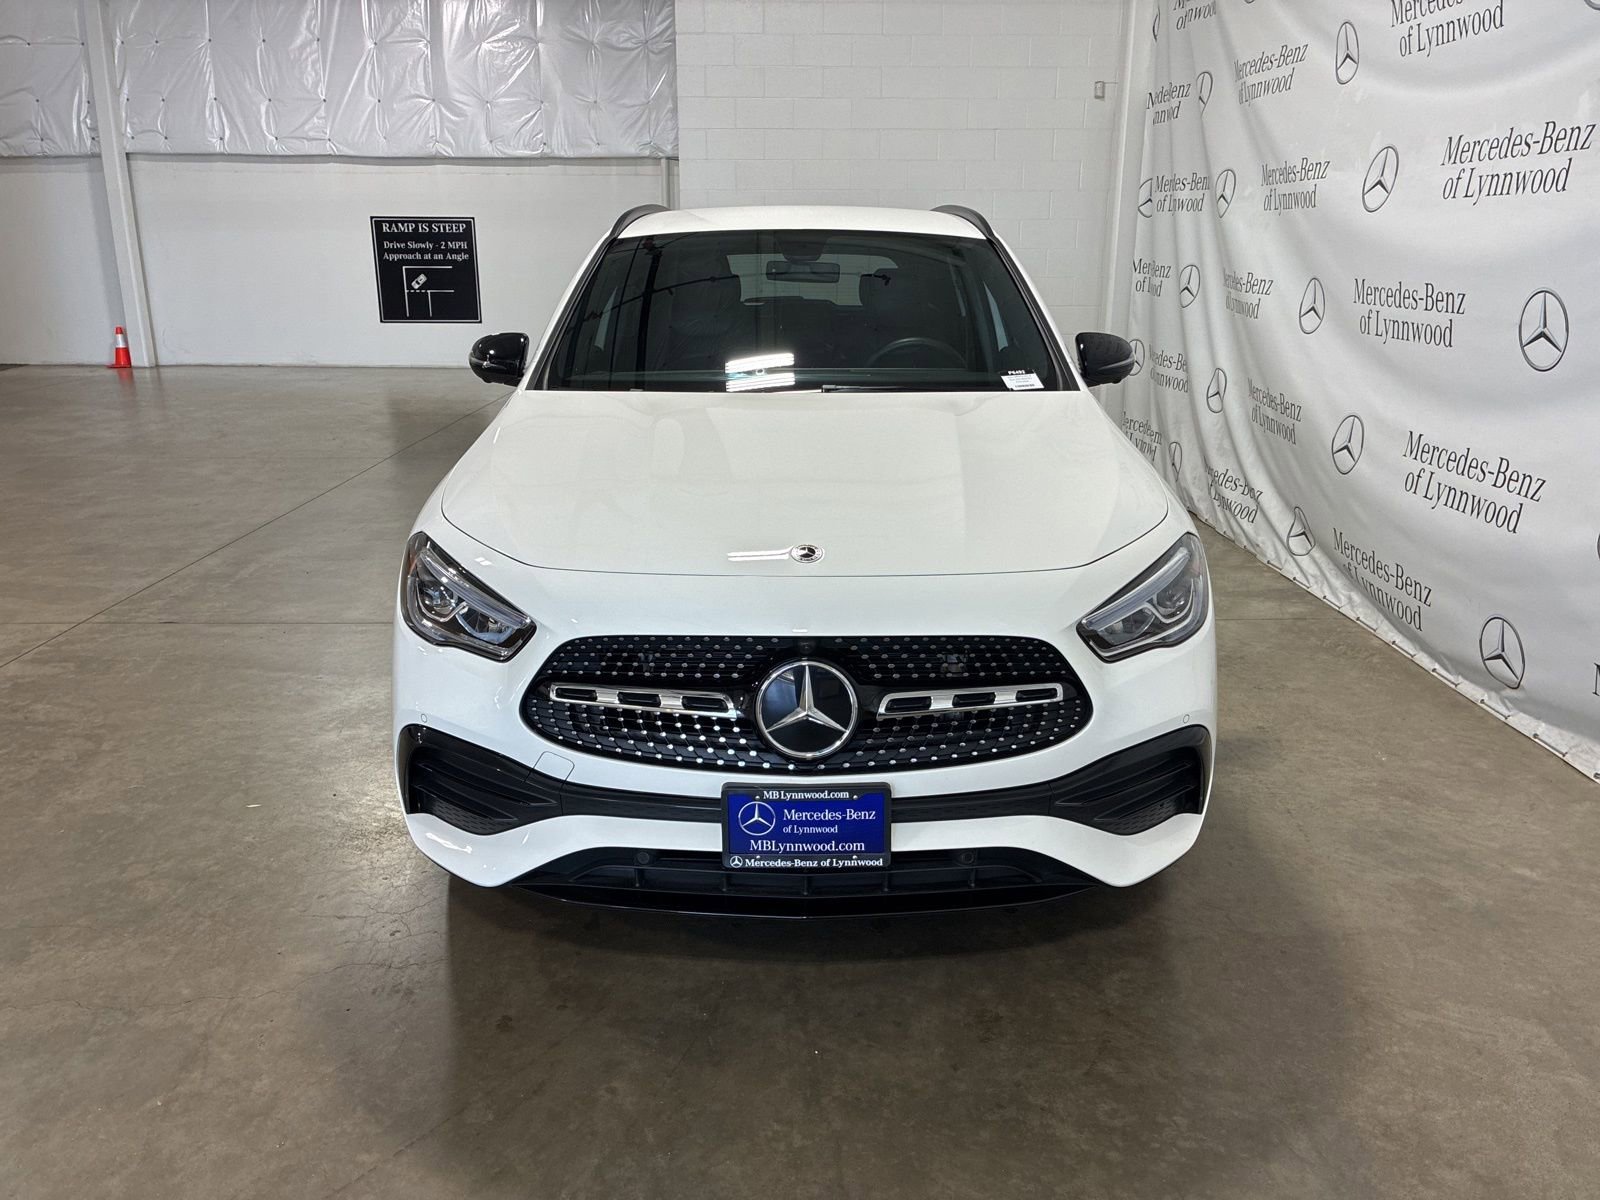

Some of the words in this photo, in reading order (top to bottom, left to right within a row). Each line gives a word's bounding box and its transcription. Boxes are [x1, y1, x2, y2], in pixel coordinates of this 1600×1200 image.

[1391, 0, 1463, 28] Merce
[1399, 25, 1414, 57] of
[1415, 0, 1505, 58] Lynnwood
[1243, 67, 1296, 107] Lynnwood
[1439, 120, 1597, 167] Mercedes-Benz
[1260, 157, 1331, 187] Mercedes-Benz
[1442, 168, 1466, 200] of
[1462, 157, 1573, 206] Lynnwood
[1156, 194, 1169, 213] of
[1263, 188, 1274, 211] of
[1273, 183, 1318, 216] Lynnwood
[382, 222, 416, 233] RAMP
[418, 222, 429, 233] IS
[432, 222, 467, 233] STEEP
[383, 241, 406, 249] Drive
[407, 241, 434, 251] Slowly
[440, 241, 446, 249] 2
[447, 241, 468, 249] MPH
[383, 252, 422, 261] Approach
[446, 252, 469, 261] Angle
[1135, 276, 1148, 293] of
[1353, 278, 1466, 315] Mercedes-Benz
[1359, 309, 1373, 335] of
[1374, 310, 1453, 348] Lynnwood
[1257, 405, 1297, 446] Lynnwood
[1403, 430, 1547, 503] Mercedes-Benz
[1404, 468, 1426, 495] of
[1422, 471, 1524, 534] Lynnwood
[1333, 527, 1433, 608] Mercedes-Benz
[782, 825, 792, 833] of
[793, 825, 838, 835] Lynnwood
[783, 808, 876, 821] Mercedes-Benz
[750, 839, 866, 853] MBLynnwood.com
[745, 858, 818, 867] Mercedes-Benz
[820, 858, 832, 867] of
[832, 858, 883, 868] Lynnwood
